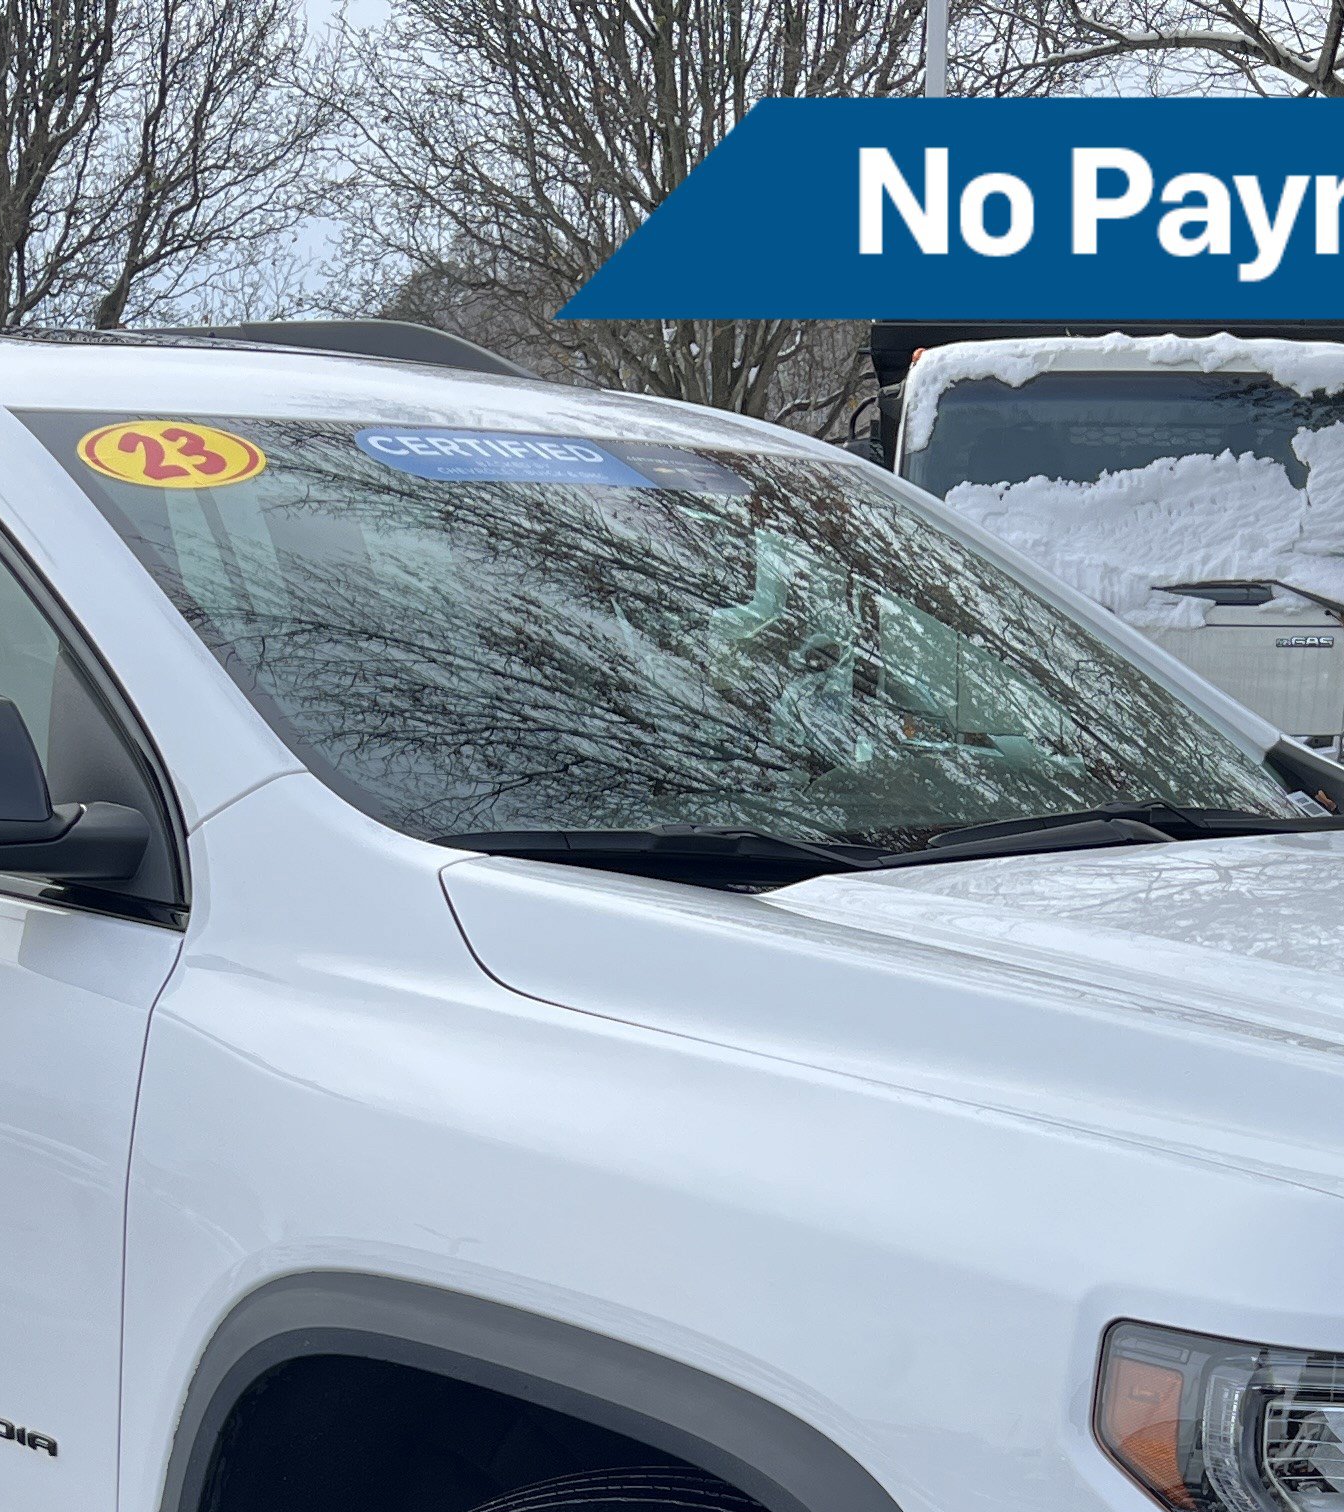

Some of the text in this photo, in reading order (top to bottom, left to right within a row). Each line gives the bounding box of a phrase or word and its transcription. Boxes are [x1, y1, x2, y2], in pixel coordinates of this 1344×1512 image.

[117, 428, 228, 480] 23
[366, 436, 604, 463] CERTIFIED
[1291, 636, 1334, 647] GAS
